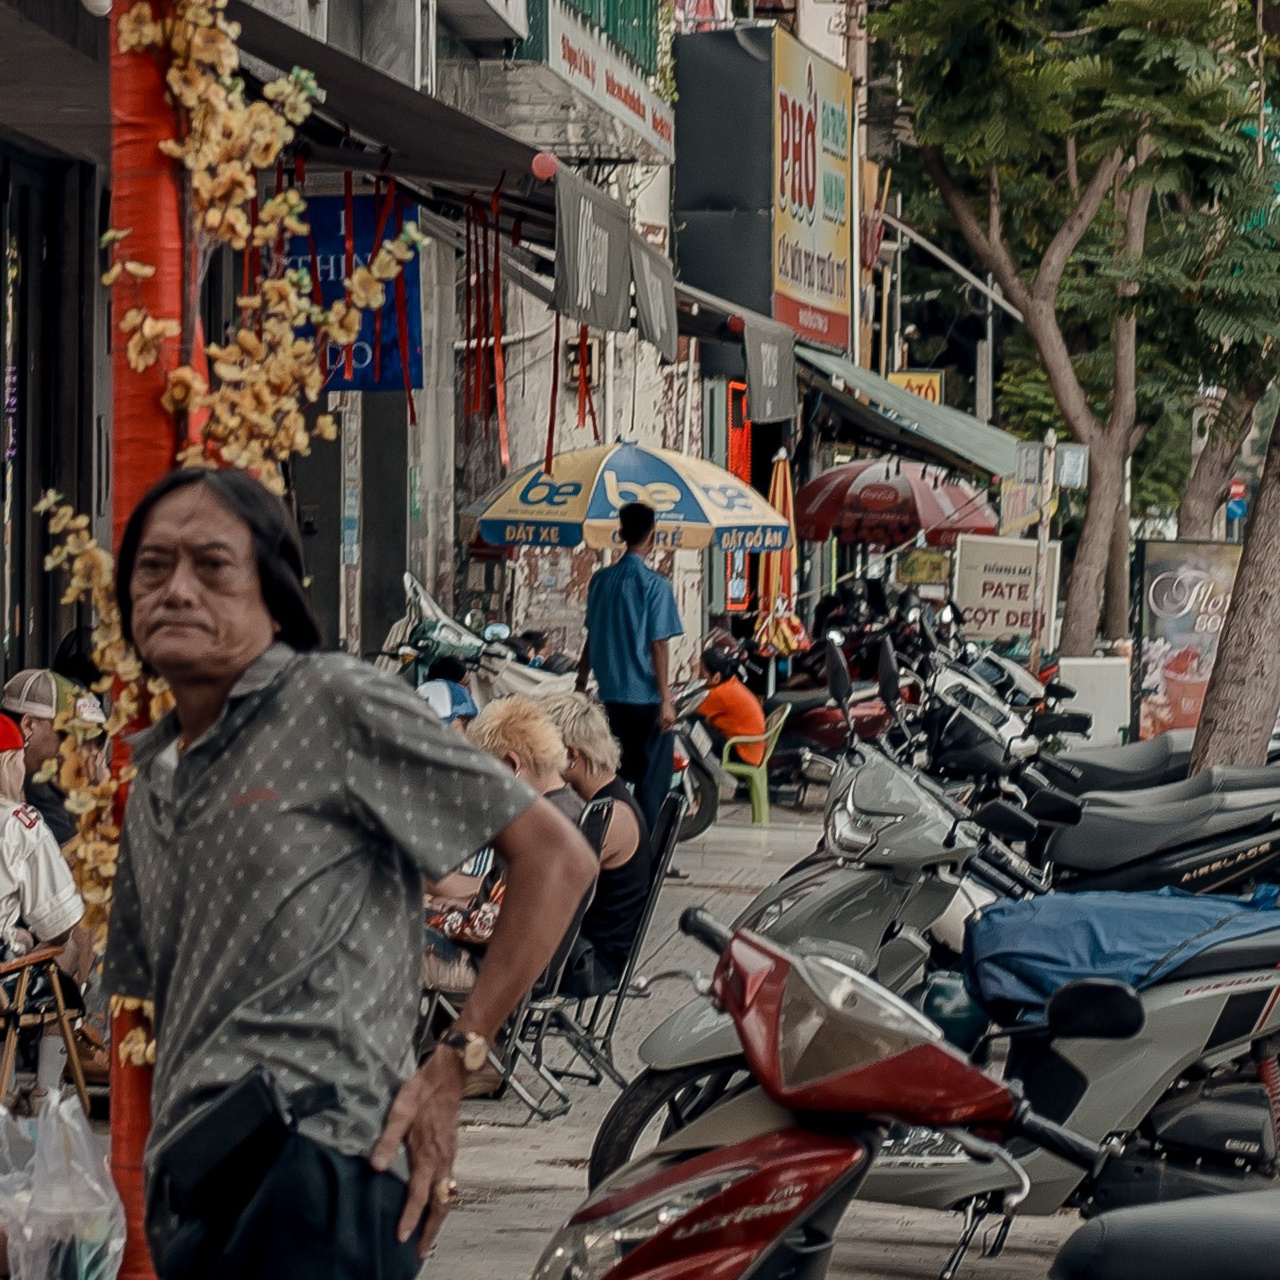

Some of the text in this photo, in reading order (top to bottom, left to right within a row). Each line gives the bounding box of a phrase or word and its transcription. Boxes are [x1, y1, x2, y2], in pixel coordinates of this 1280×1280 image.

[779, 62, 818, 218] PHỞ
[326, 341, 374, 370] DO
[519, 471, 582, 506] be
[603, 470, 683, 513] be
[538, 526, 560, 545] XE
